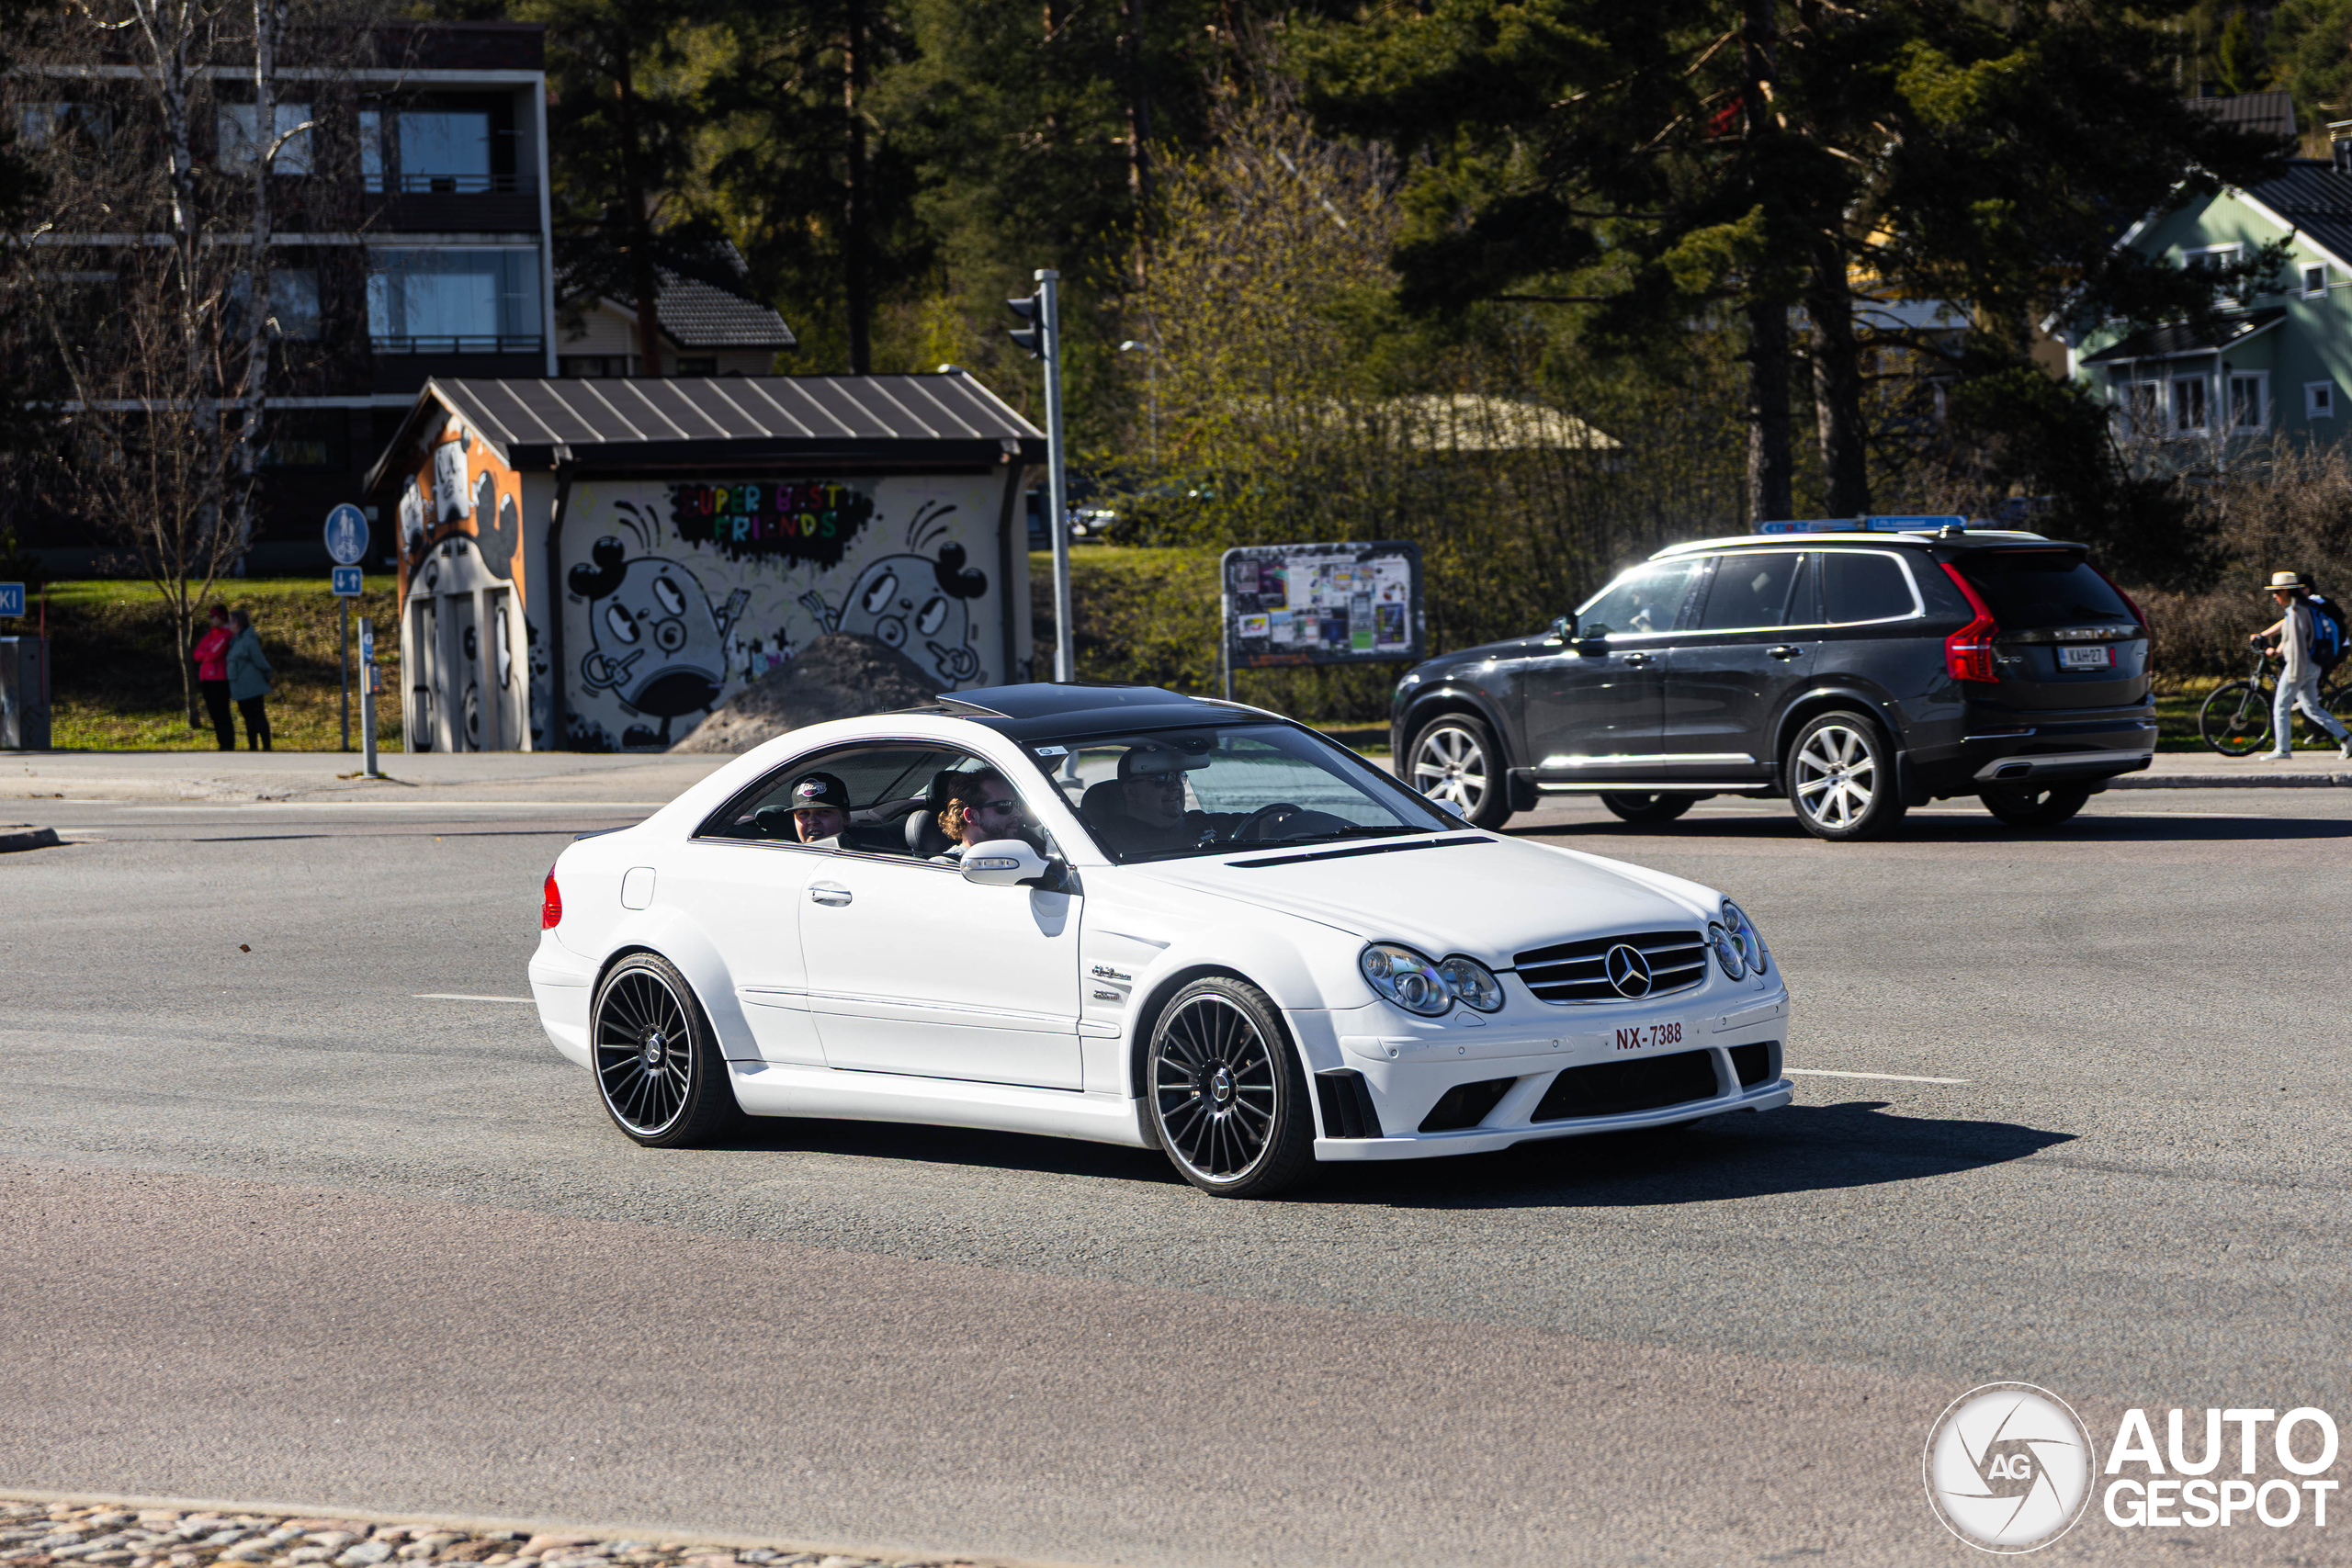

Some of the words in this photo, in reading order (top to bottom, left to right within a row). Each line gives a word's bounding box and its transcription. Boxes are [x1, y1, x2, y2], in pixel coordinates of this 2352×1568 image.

[681, 485, 761, 517] SUPER
[775, 484, 842, 512] BEST
[715, 512, 836, 541] FRIENDS
[1616, 1022, 1682, 1050] NX-7388
